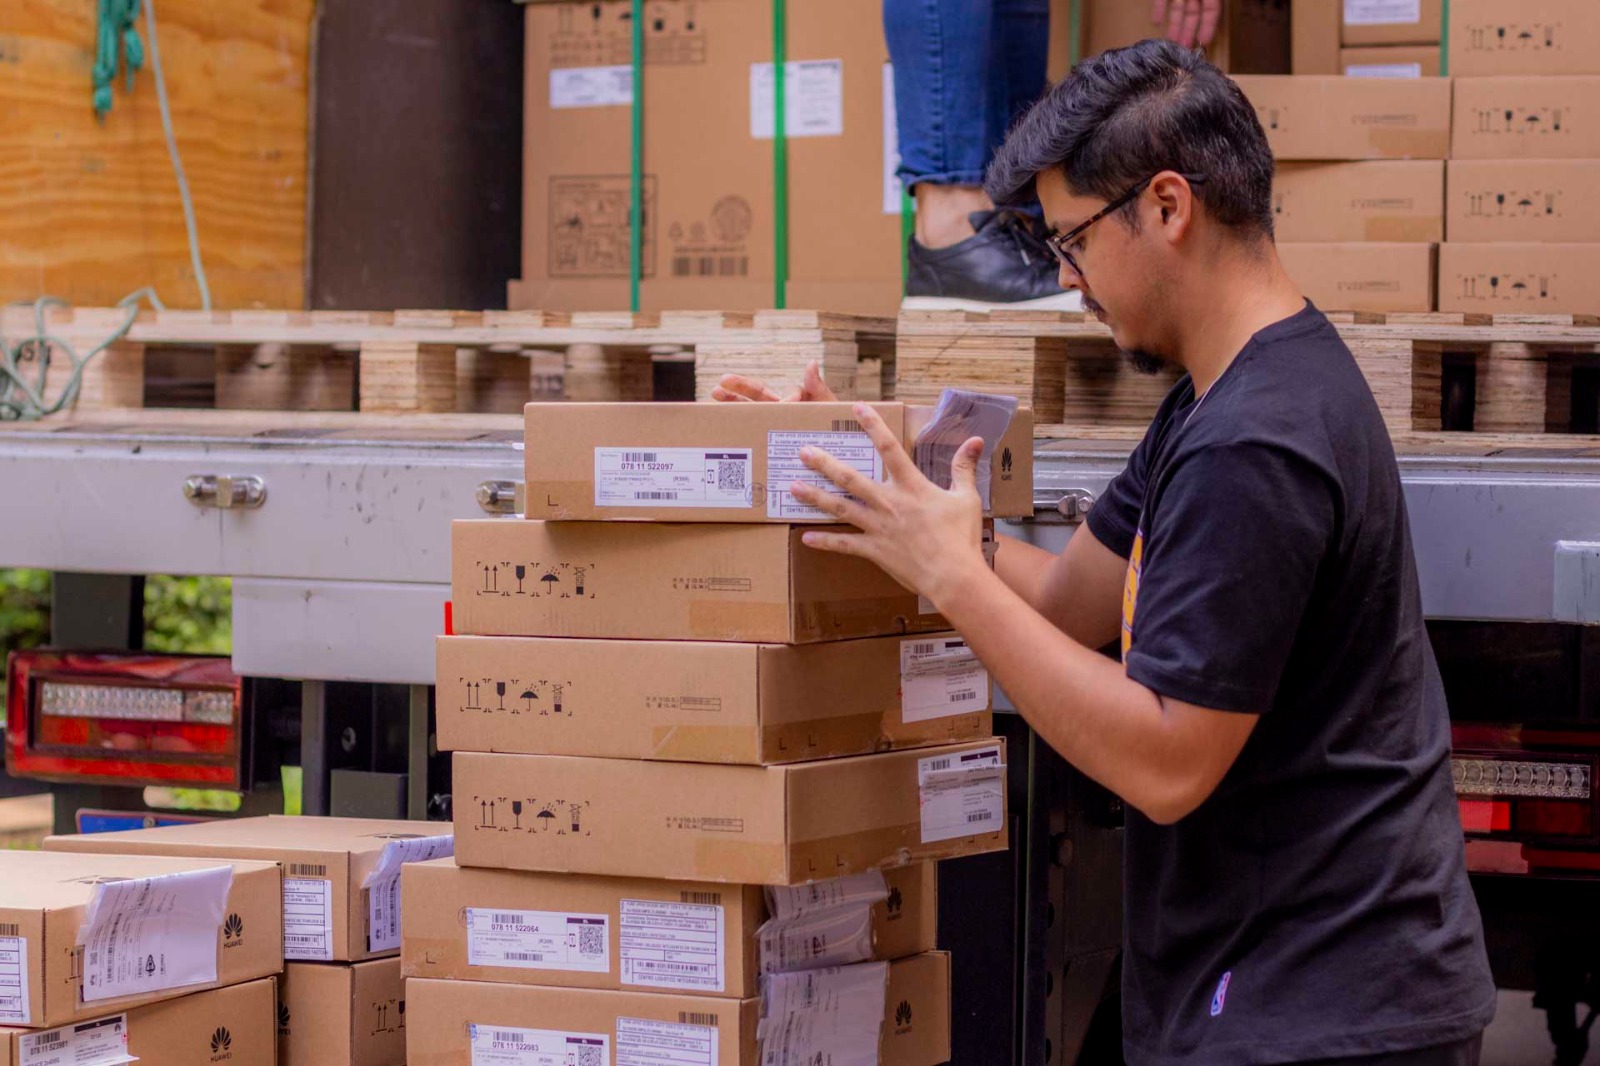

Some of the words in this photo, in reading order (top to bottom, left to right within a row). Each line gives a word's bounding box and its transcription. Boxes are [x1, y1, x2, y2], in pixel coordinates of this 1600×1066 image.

[621, 462, 634, 470] 078
[637, 462, 645, 470] 11
[647, 462, 674, 470] 522097
[223, 938, 244, 950] HUAWEI
[42, 1045, 48, 1053] 11
[492, 1041, 504, 1049] 078
[210, 1052, 232, 1064] HUAWEI
